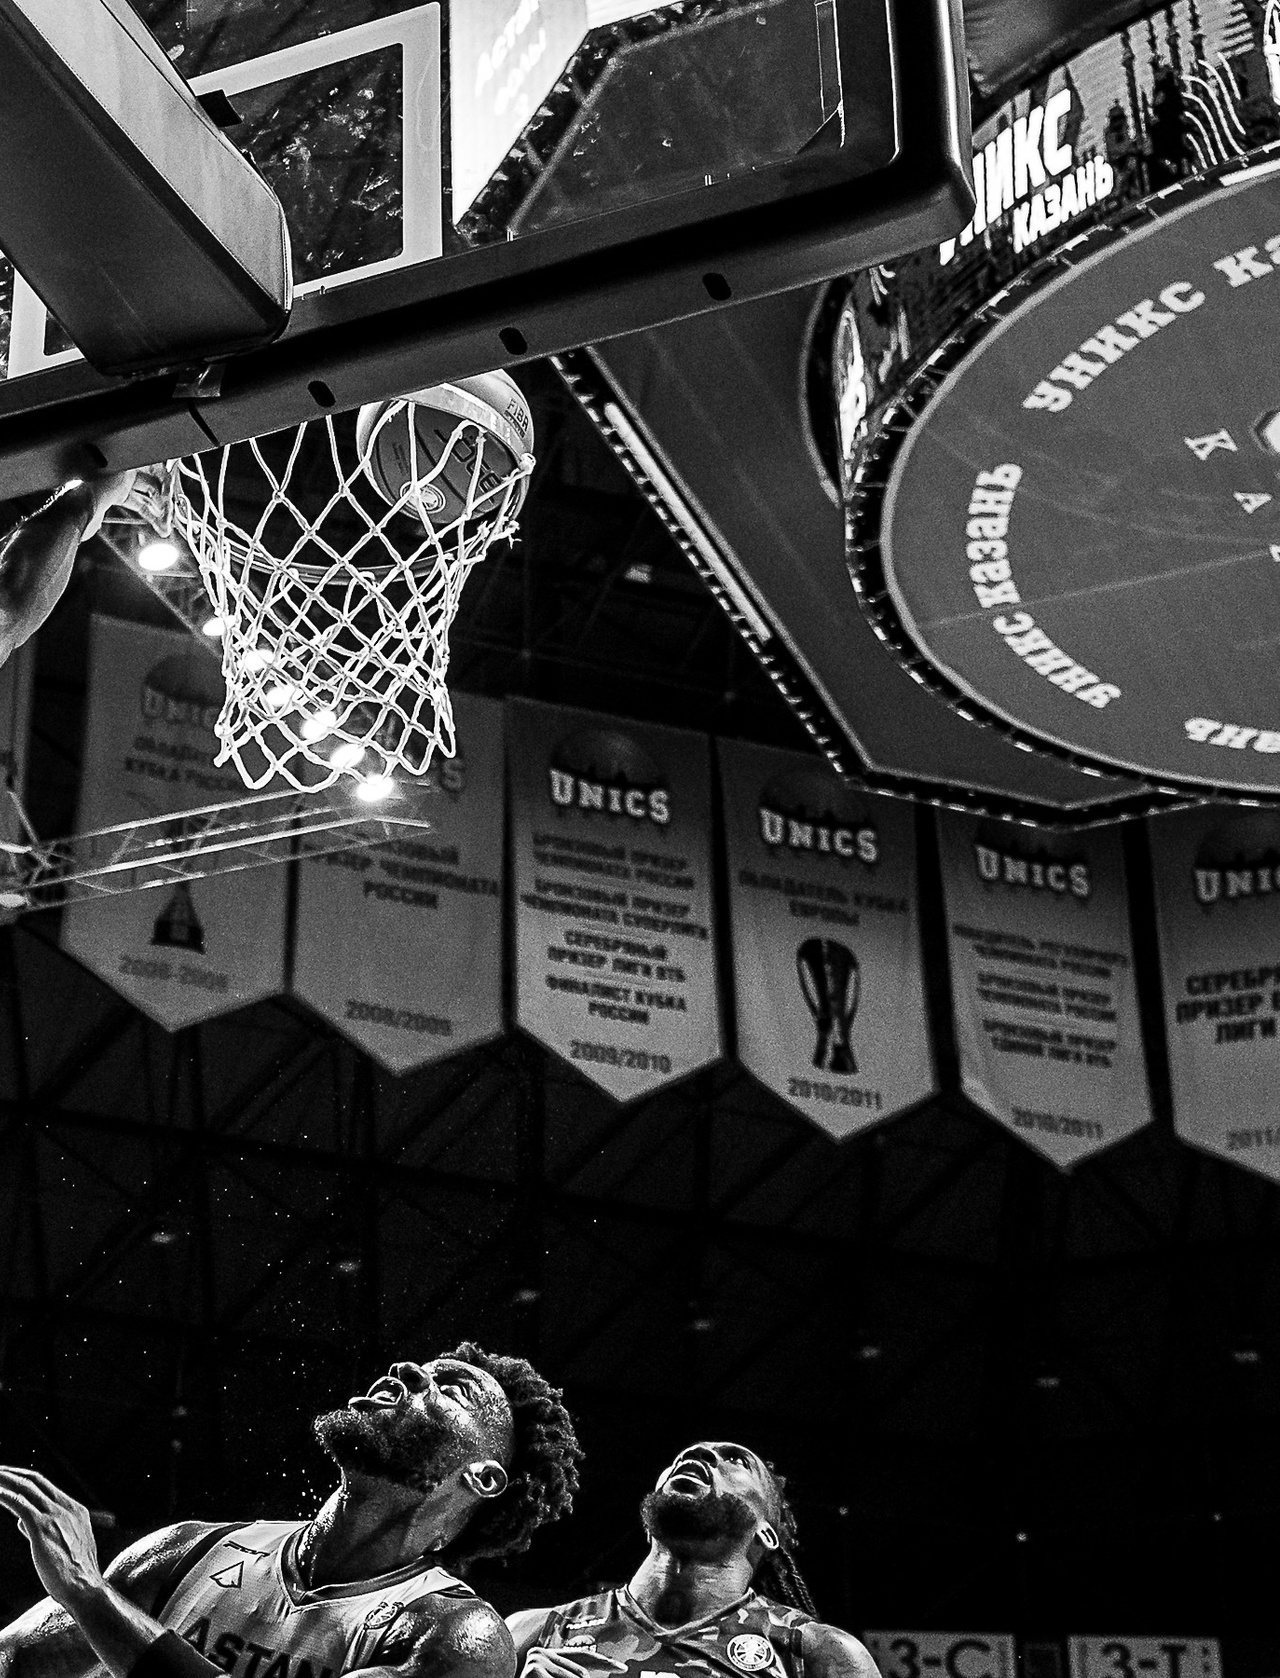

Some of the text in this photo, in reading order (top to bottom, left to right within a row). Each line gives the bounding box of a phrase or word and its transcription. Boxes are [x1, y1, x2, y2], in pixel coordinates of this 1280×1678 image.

[1013, 155, 1114, 254] КАЗАНЬ
[1022, 281, 1206, 413] УНИКС
[549, 768, 671, 825] UNICS
[760, 807, 877, 862] UNICS
[975, 844, 1090, 897] UNICS
[1195, 866, 1280, 901] UNI
[1176, 993, 1263, 1026] ПРИЗЕР
[570, 1039, 671, 1074] 2009/2010
[788, 1077, 882, 1110] 2010/2011
